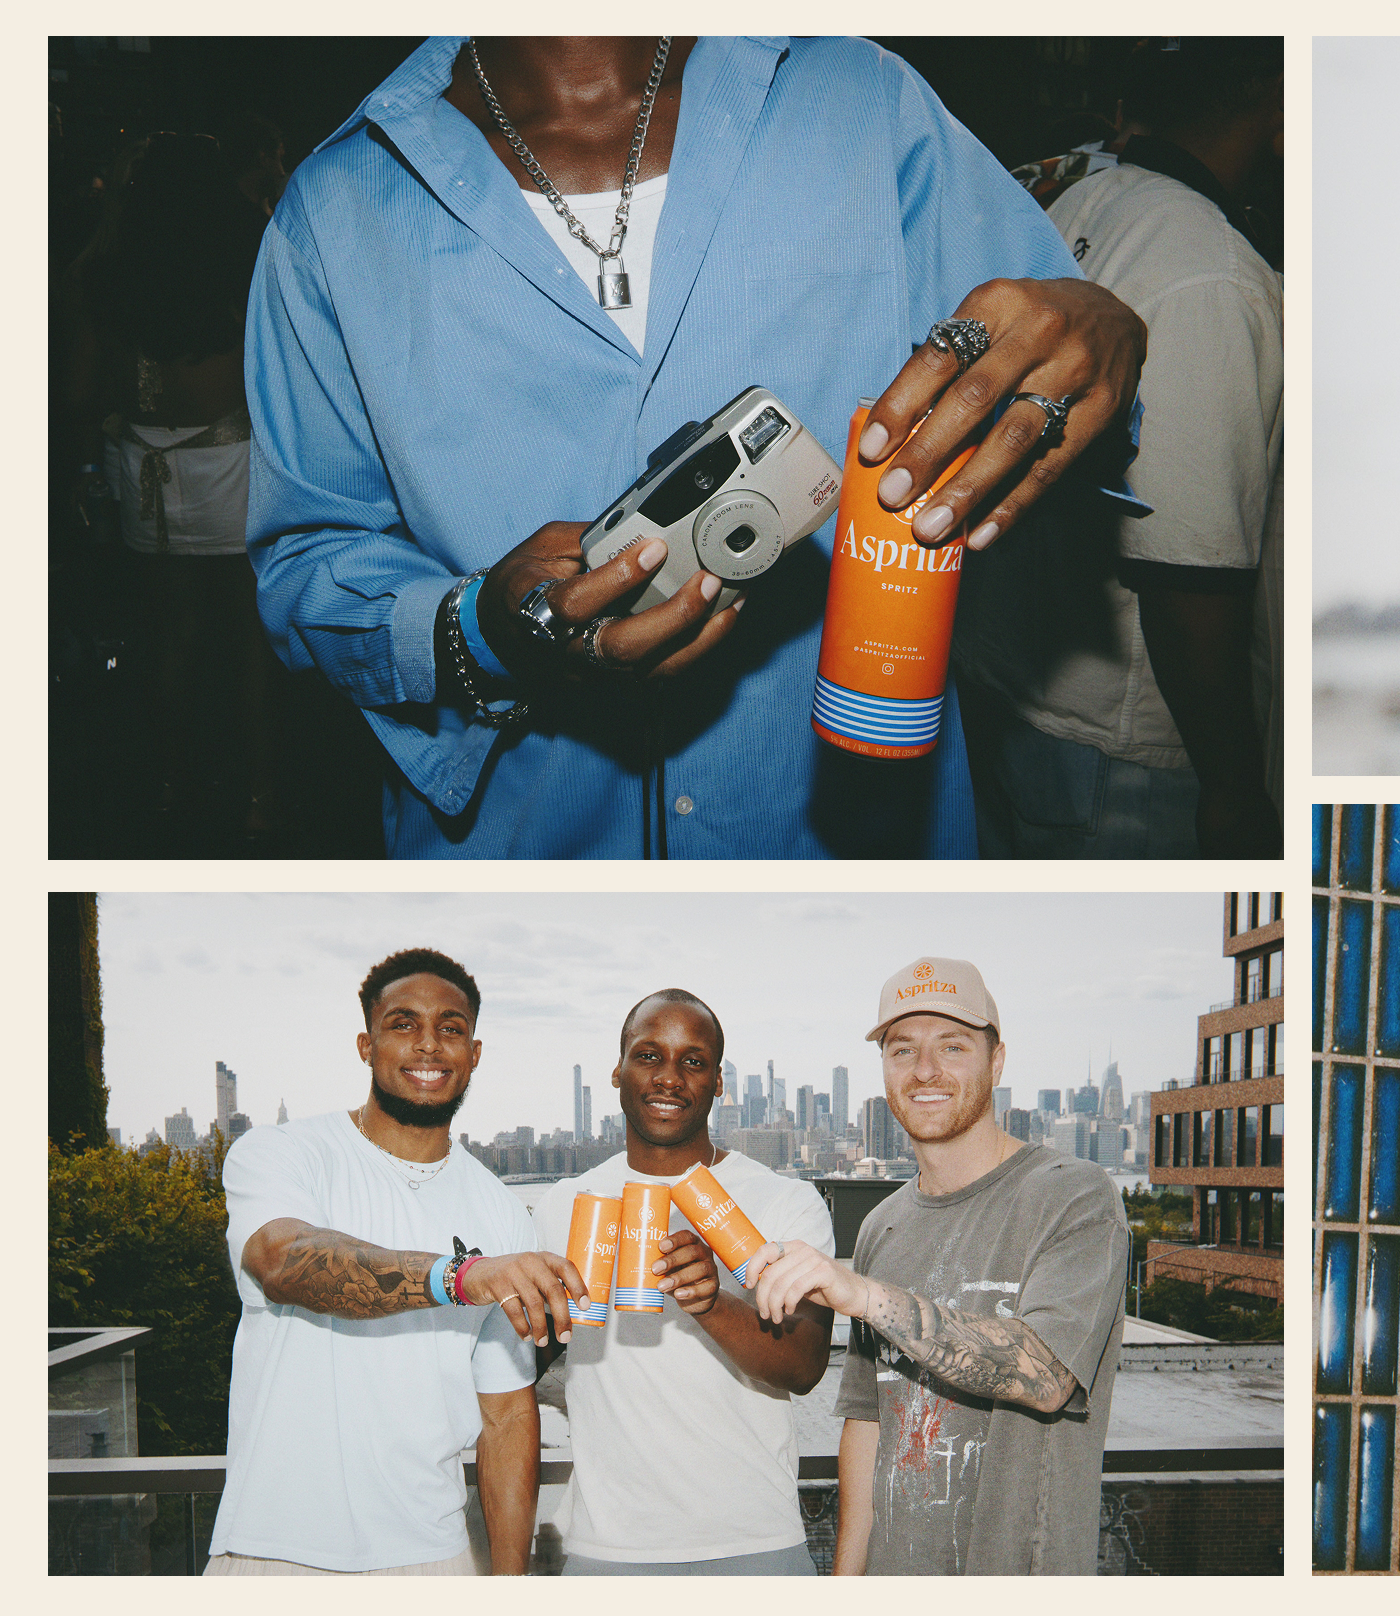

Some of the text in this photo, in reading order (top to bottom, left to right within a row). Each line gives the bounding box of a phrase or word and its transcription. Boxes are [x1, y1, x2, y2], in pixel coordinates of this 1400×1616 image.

[702, 523, 713, 547] CANON
[713, 507, 732, 522] ZOOM
[880, 582, 919, 596] SPRITZ
[853, 645, 926, 661] @ASPRITZAOFFICIAL
[864, 639, 919, 653] ASPRITZA.COM
[830, 734, 839, 744] 5%
[839, 739, 852, 749] ALC.
[875, 747, 883, 756] 12
[884, 748, 891, 756] FL
[892, 749, 901, 757] OZ
[894, 979, 958, 1005] Aspritza
[696, 1198, 737, 1234] Aspritza
